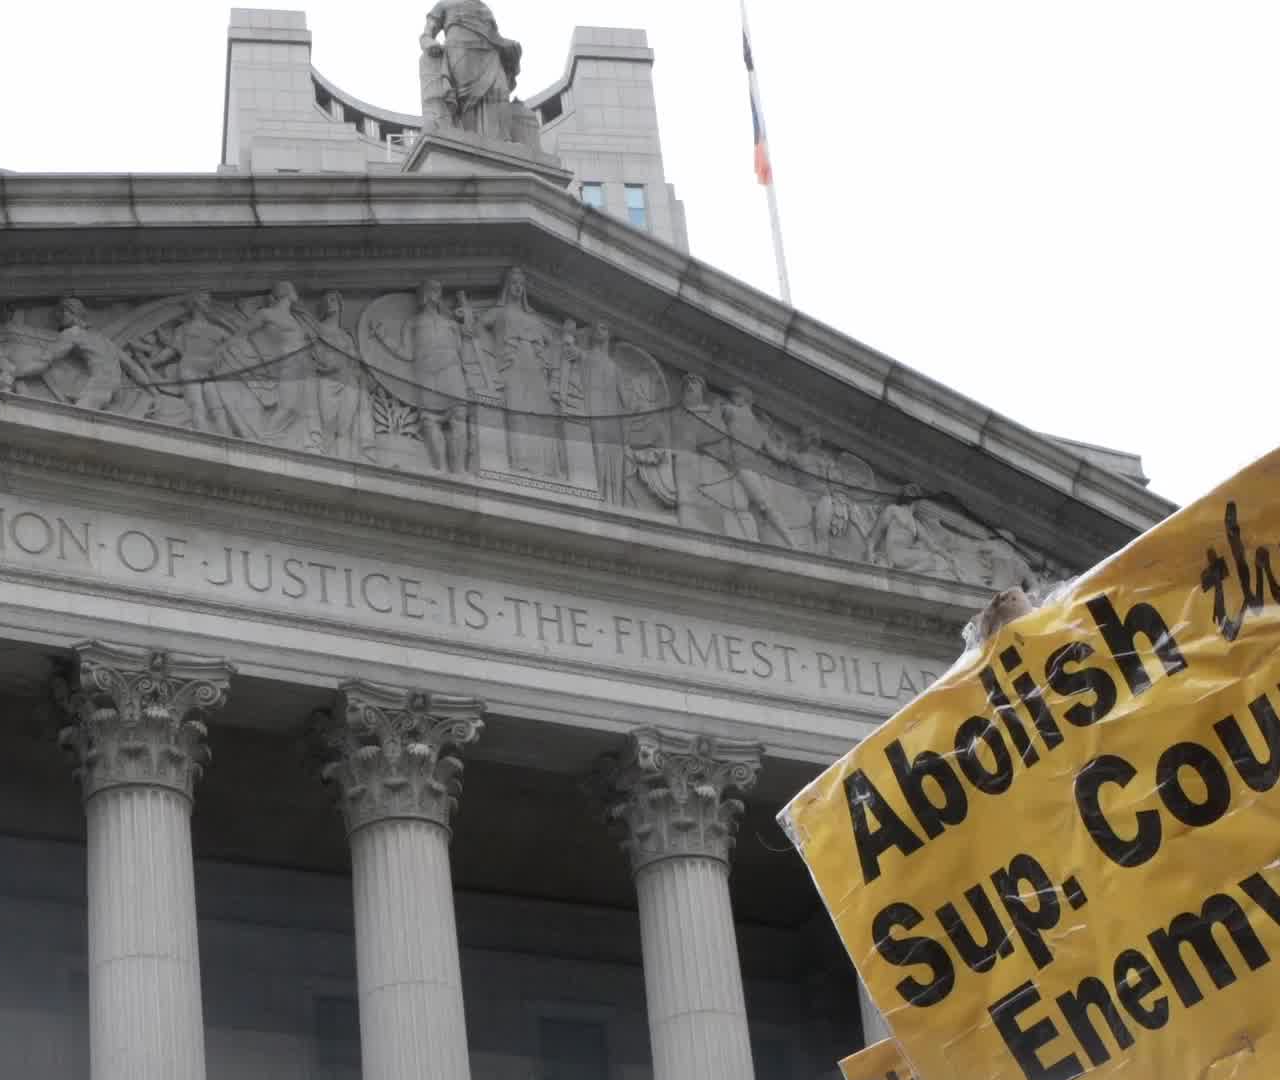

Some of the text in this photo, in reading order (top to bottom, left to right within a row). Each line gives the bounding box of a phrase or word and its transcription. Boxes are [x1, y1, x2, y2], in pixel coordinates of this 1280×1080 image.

[116, 529, 188, 578] OF
[204, 545, 426, 620] JUSTICE
[446, 585, 490, 631] IS
[503, 596, 595, 649] THE
[613, 614, 796, 683] FIRMEST
[842, 593, 1189, 885] Abolish
[871, 852, 1088, 1008] Sup.
